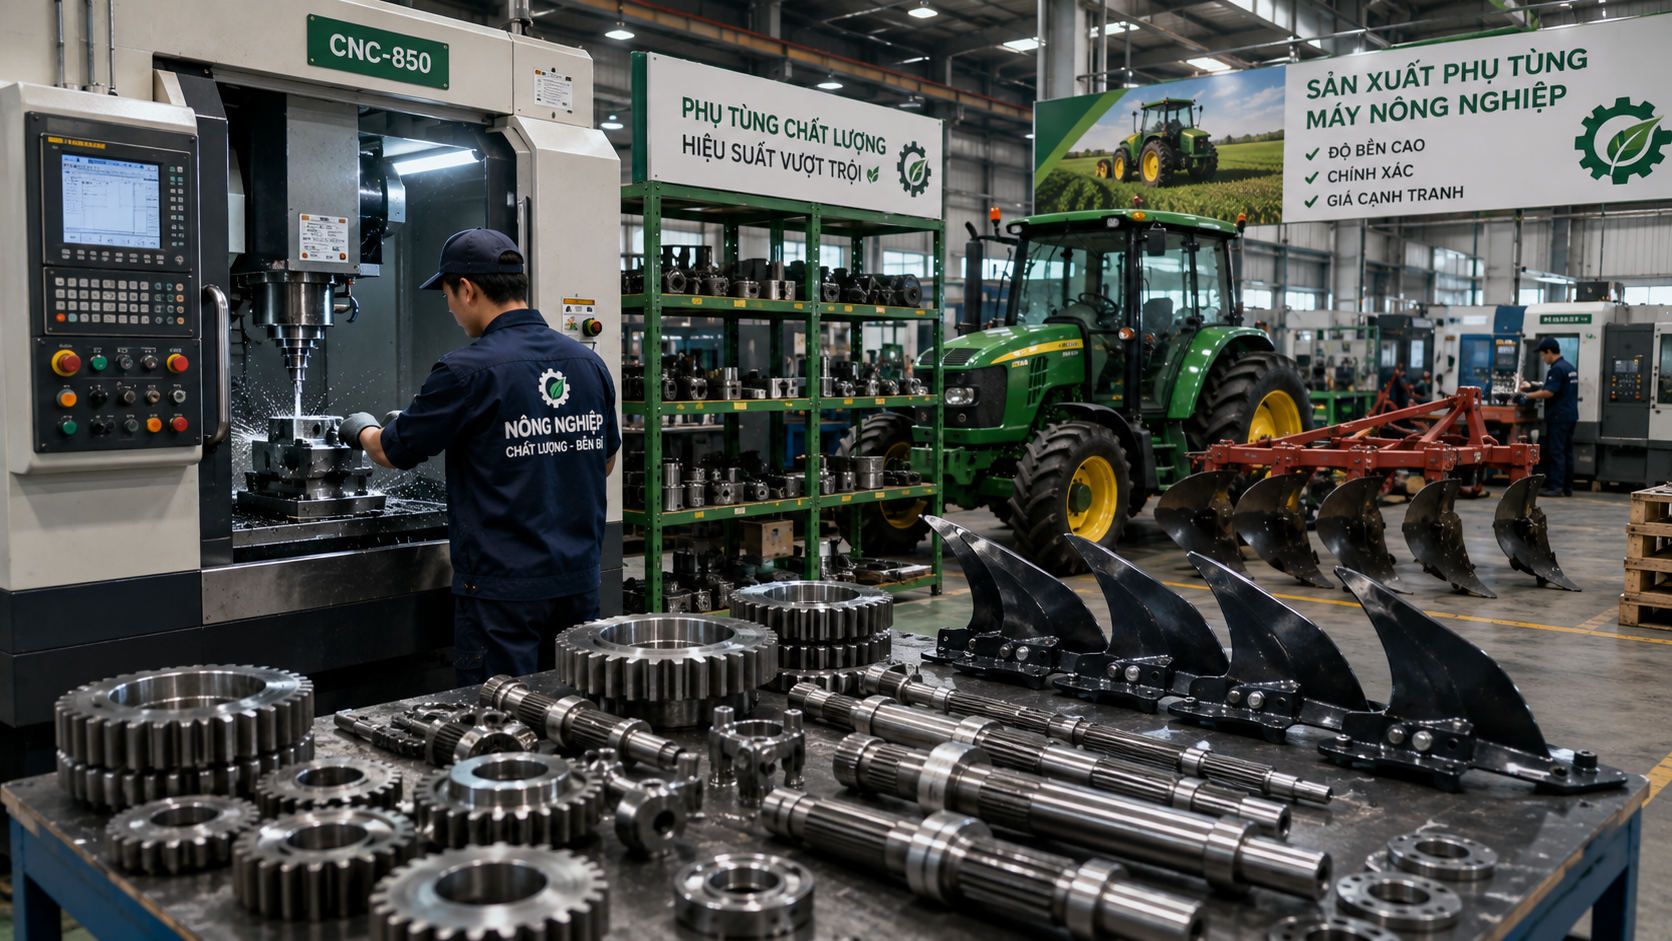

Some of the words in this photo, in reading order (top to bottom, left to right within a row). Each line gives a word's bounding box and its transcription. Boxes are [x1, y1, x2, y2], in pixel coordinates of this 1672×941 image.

[329, 33, 432, 74] CNC-850
[1306, 71, 1357, 99] SẢN
[1366, 59, 1435, 93] XUẤT
[1443, 58, 1499, 85] PHỤ
[1507, 48, 1588, 77] TÙNG
[682, 96, 722, 129] PHỤ
[727, 103, 779, 135] TÙNG
[784, 117, 829, 144] CHẤT
[833, 128, 887, 156] LƯỢNG
[1306, 102, 1361, 130] MÁY
[1370, 95, 1449, 124] NÔNG
[1459, 81, 1567, 116] NGHIỆP
[682, 133, 725, 163] HIỆU
[731, 141, 776, 168] SUẤT
[780, 151, 825, 178] VƯỢT
[828, 159, 861, 185] TRỘI
[1328, 142, 1351, 161] ĐỘ
[1355, 138, 1386, 157] BỀN
[1391, 139, 1426, 154] CAO
[1327, 166, 1376, 183] CHÍNH
[1381, 162, 1414, 179] XÁC
[1326, 190, 1353, 207] GIÁ
[1358, 190, 1402, 207] CẠNH
[1407, 185, 1464, 202] TRANH
[504, 414, 552, 440] NÔNG
[554, 409, 603, 436] NGHIỆP
